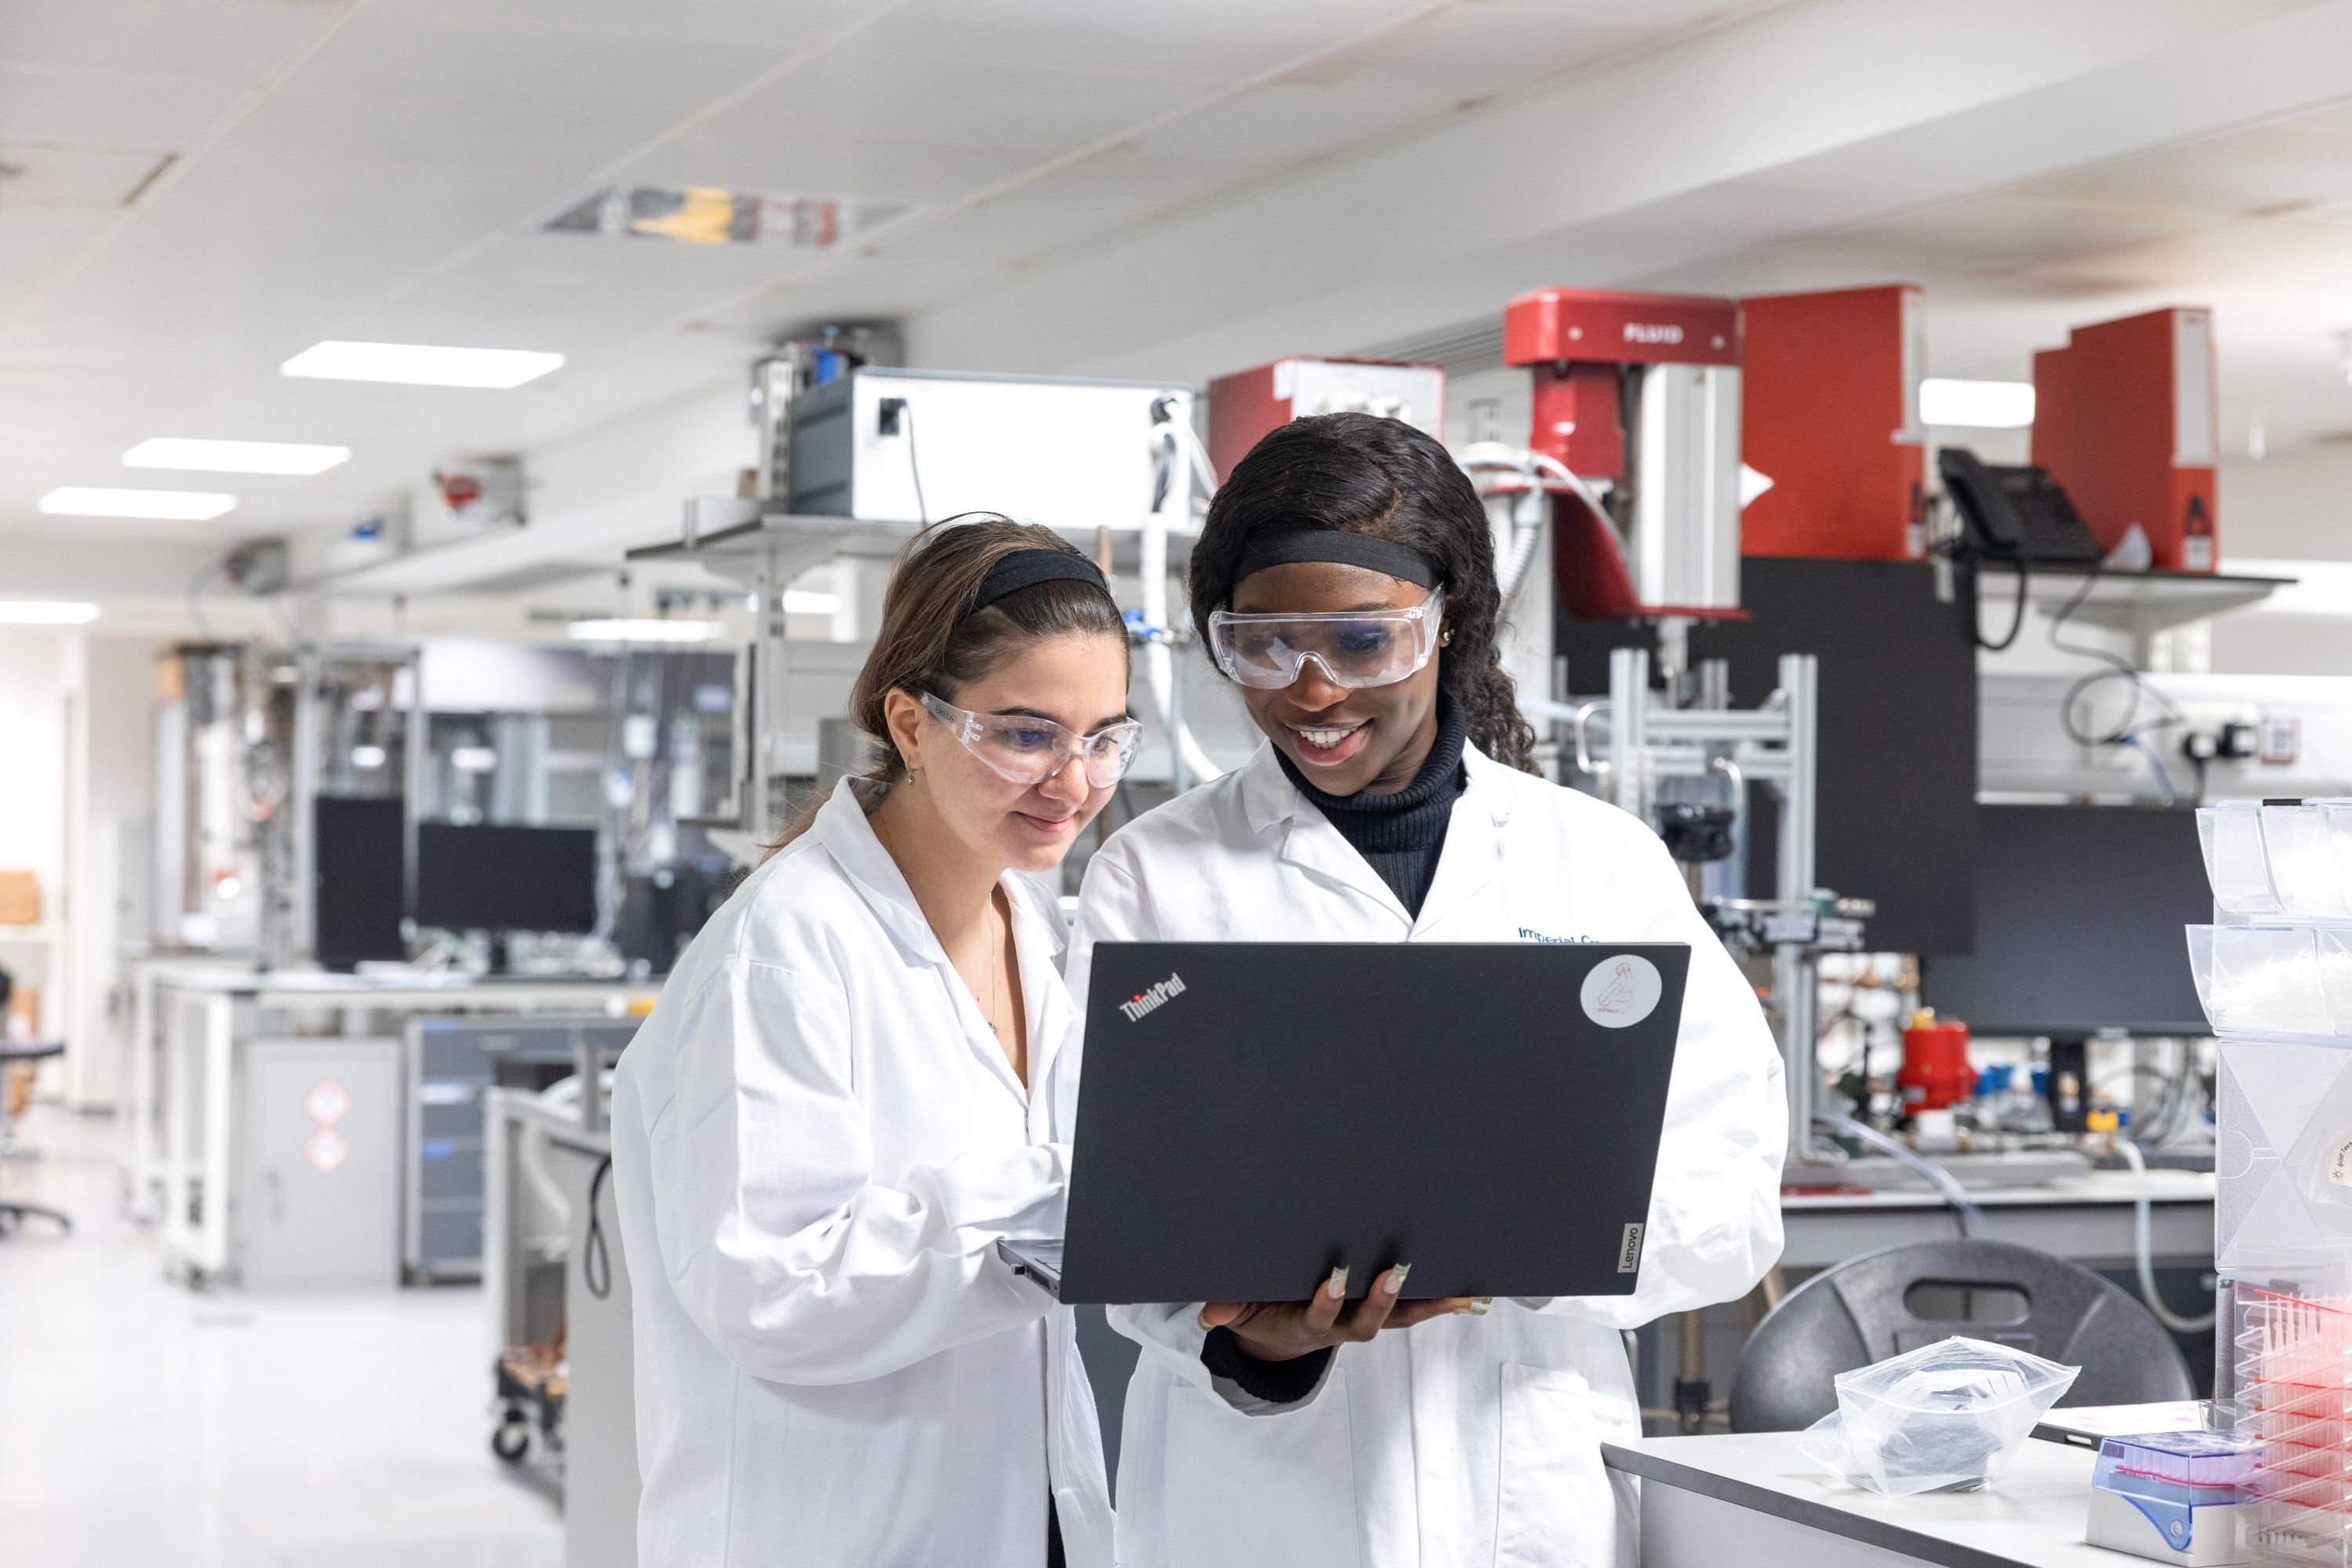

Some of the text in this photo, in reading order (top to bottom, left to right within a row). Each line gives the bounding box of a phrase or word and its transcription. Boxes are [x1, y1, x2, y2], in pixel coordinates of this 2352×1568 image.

[1623, 322, 1684, 345] FLUID
[1119, 971, 1187, 1022] ThinkPad
[1622, 1228, 1638, 1269] Lenovo
